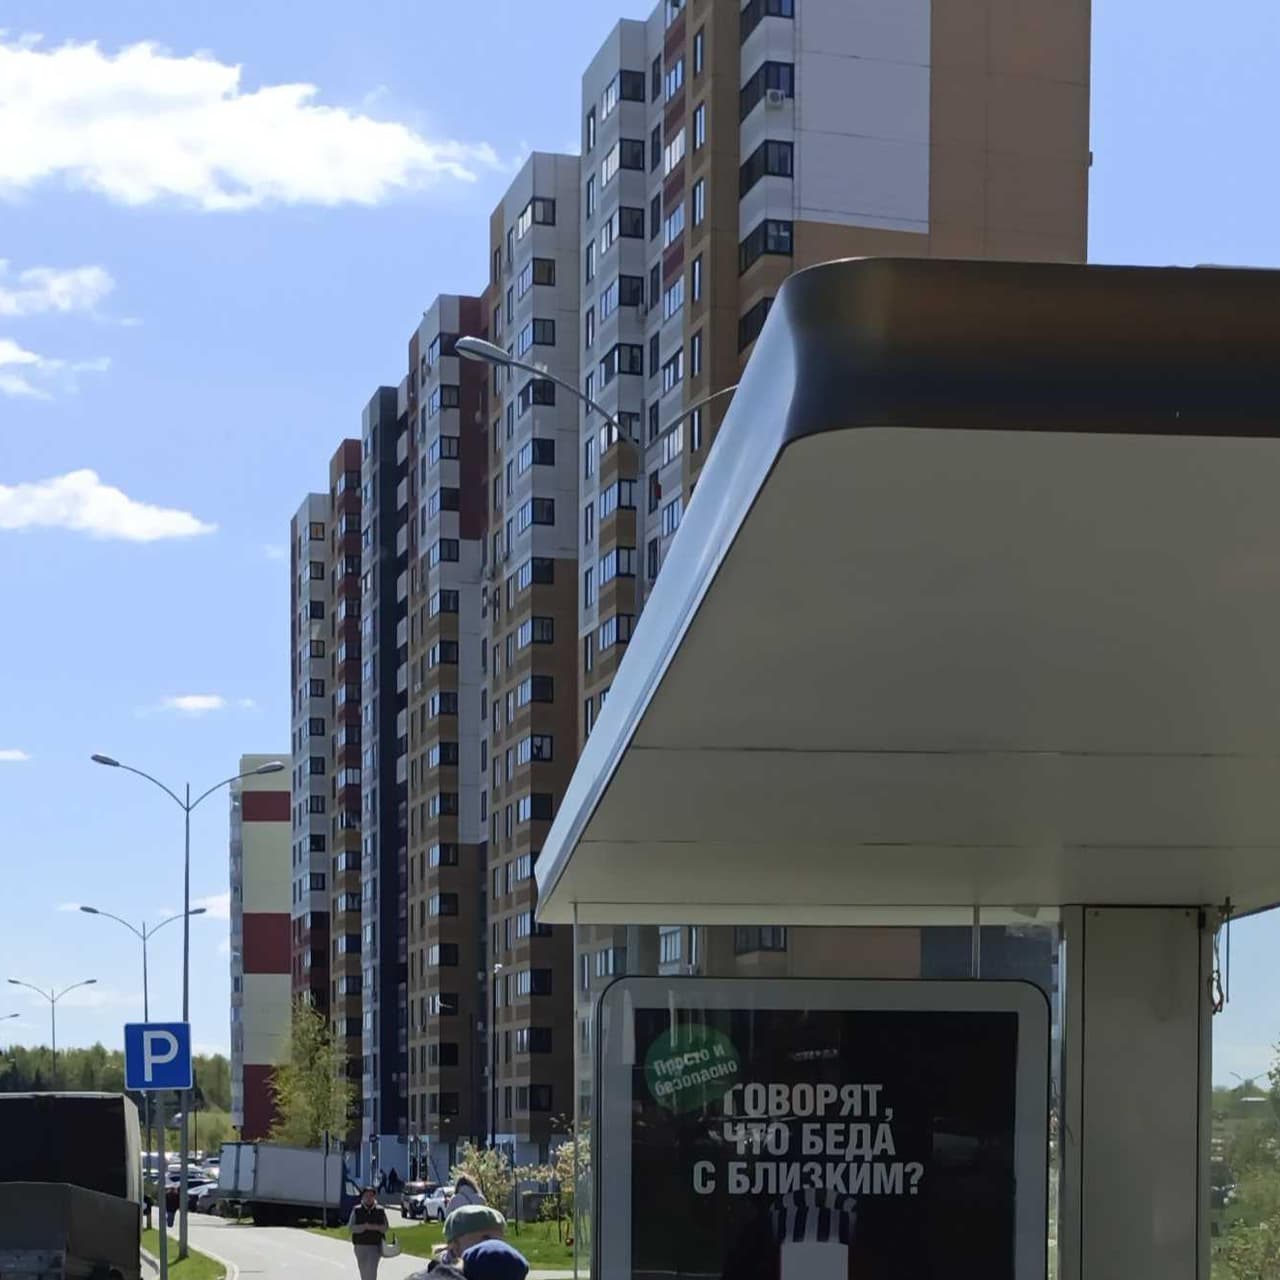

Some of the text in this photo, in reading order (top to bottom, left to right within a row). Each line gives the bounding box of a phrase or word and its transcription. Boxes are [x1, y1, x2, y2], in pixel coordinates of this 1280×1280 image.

[143, 1030, 179, 1082] P
[654, 1043, 726, 1077] Просто и
[655, 1060, 738, 1096] безопасно
[723, 1083, 893, 1121] ГОВОРЯТ,
[723, 1122, 896, 1161] ЧТО БЕДА
[693, 1161, 924, 1194] С БЛИЗКИМ?
